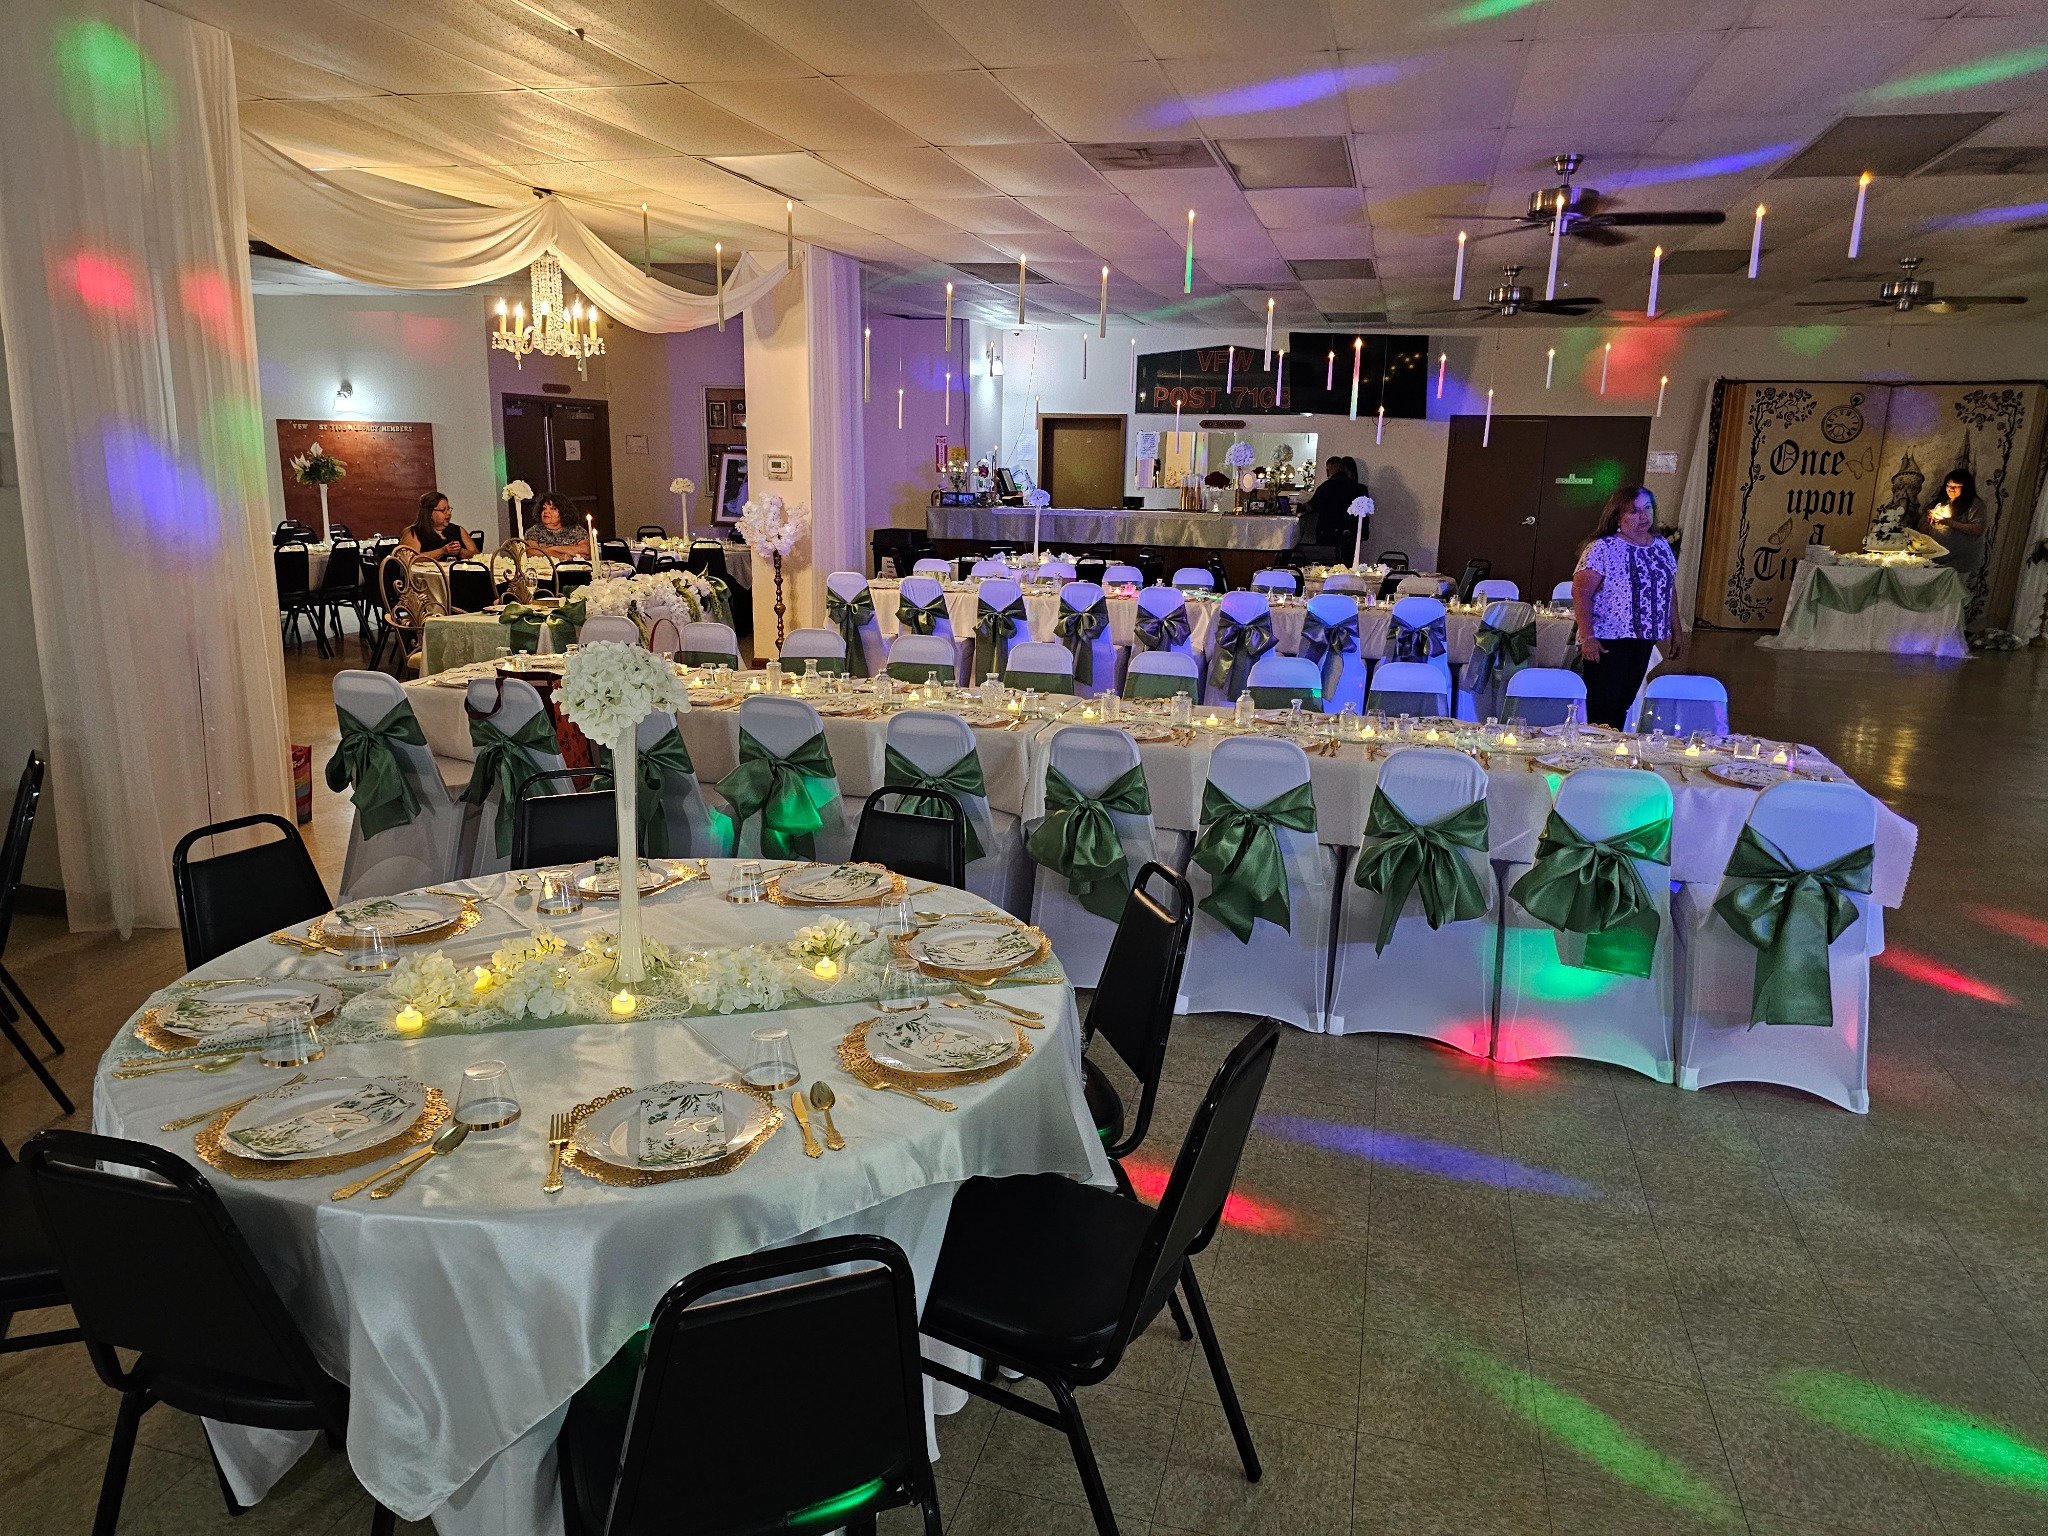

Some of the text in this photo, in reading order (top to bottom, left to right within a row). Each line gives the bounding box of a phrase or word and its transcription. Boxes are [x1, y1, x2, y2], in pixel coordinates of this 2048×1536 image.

[1197, 350, 1255, 372] VFW
[1153, 386, 1222, 409] POST
[1770, 439, 1846, 476] Once
[1787, 489, 1856, 522] upon
[1808, 523, 1825, 545] a
